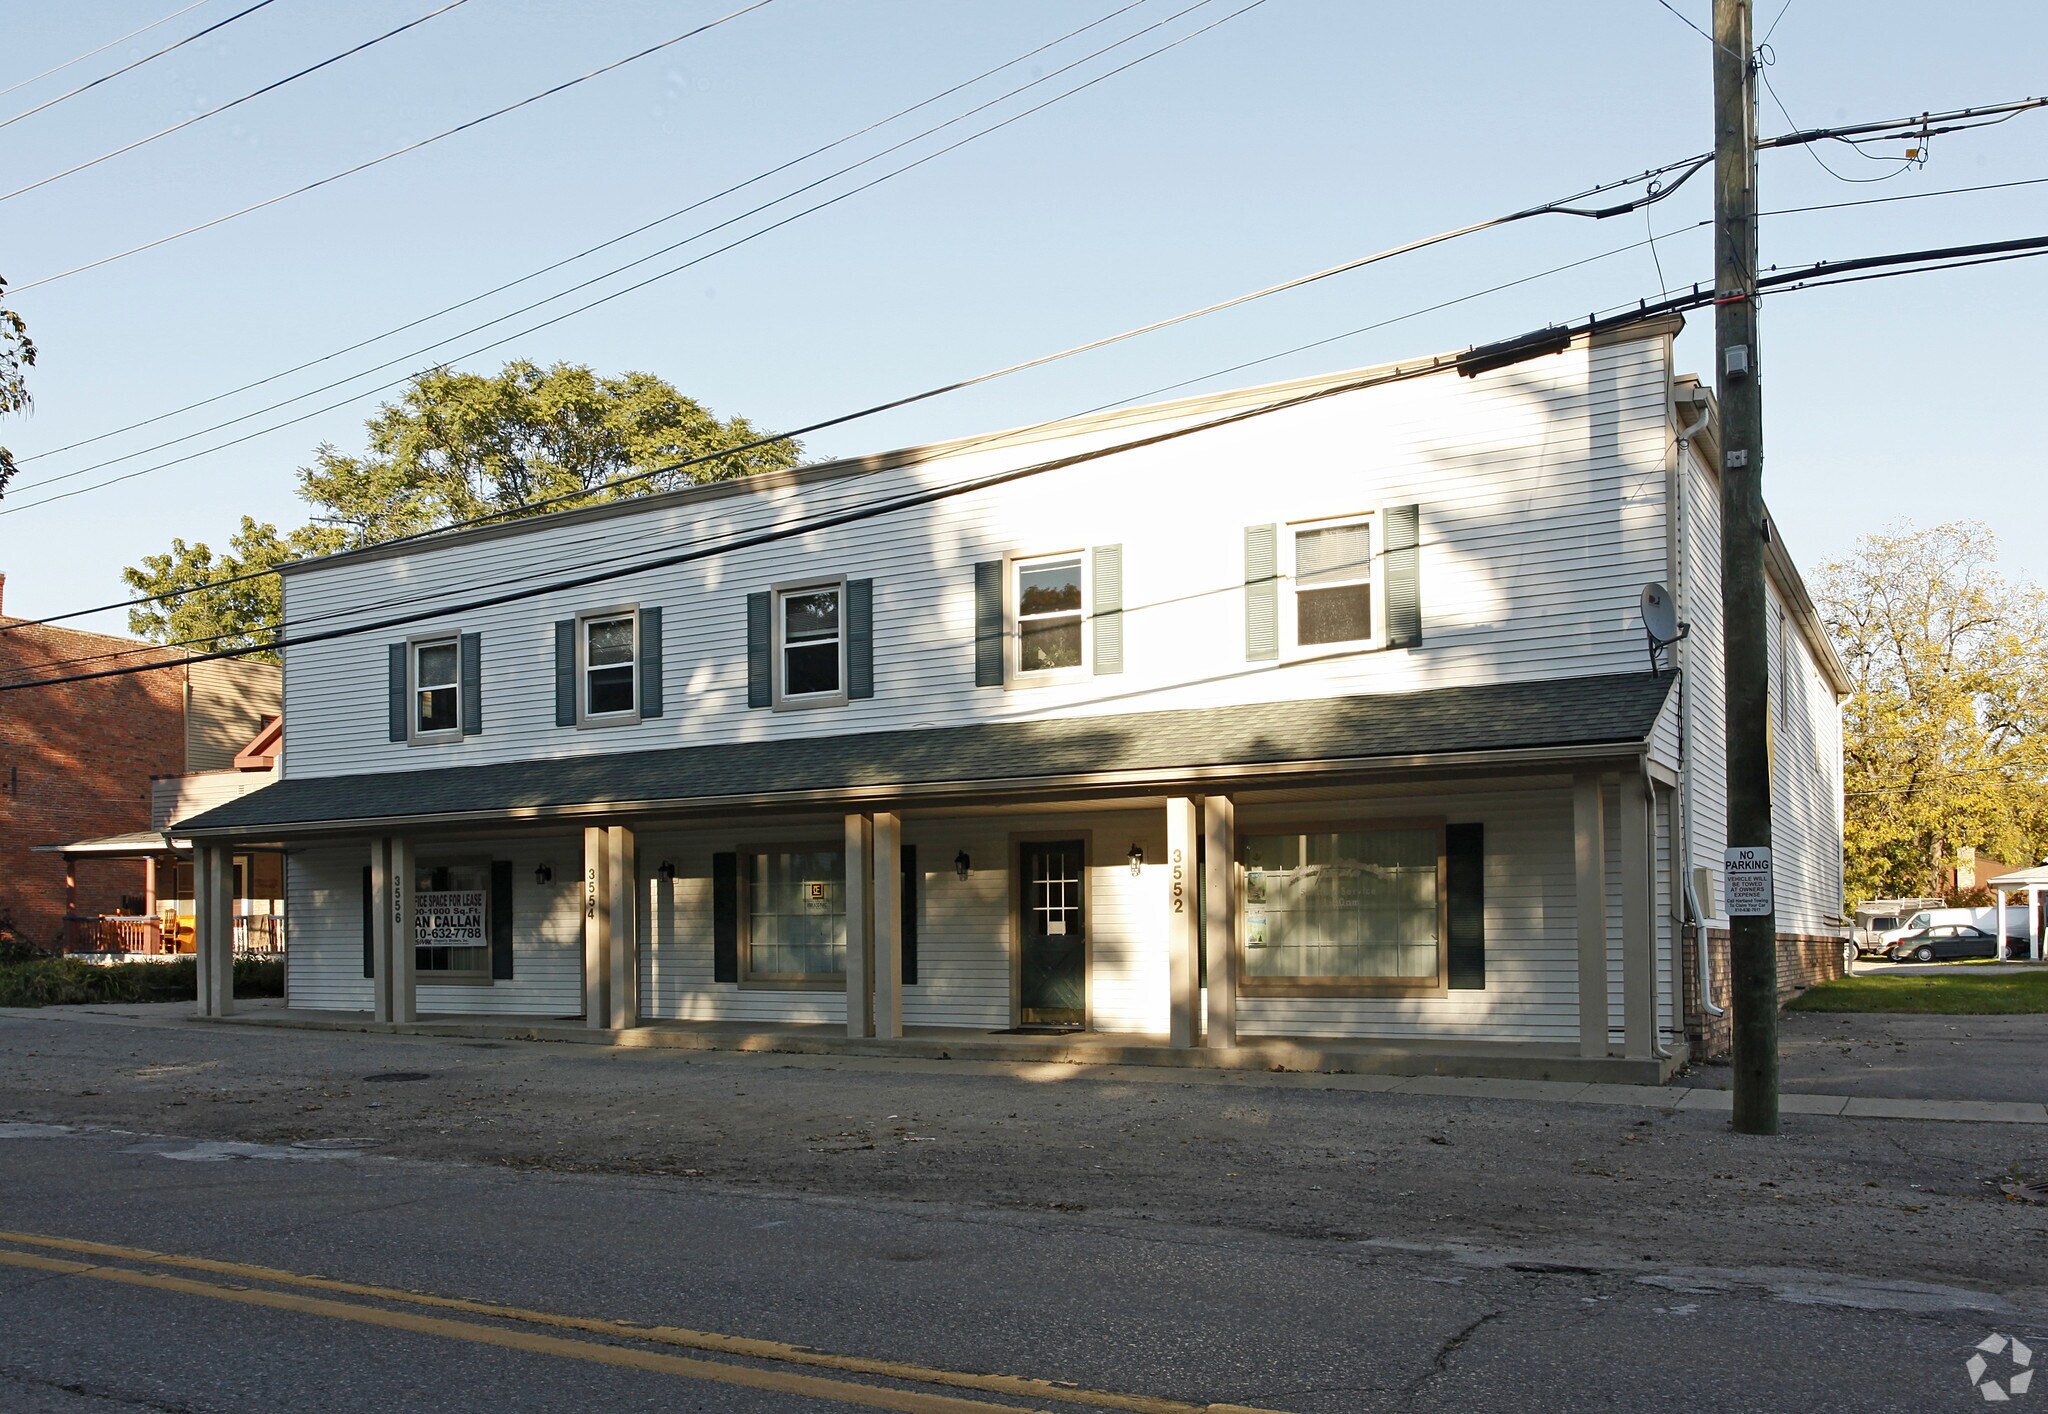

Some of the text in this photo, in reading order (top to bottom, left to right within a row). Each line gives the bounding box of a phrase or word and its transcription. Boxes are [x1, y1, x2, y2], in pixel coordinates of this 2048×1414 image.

[1740, 850, 1754, 860] NO
[1725, 860, 1769, 870] PARKING
[1173, 849, 1183, 913] 3552
[587, 868, 595, 920] 3554
[415, 893, 482, 908] FICE SPACE FOR LEASE
[415, 907, 481, 916] 00-1000 Sq.Ft.
[415, 915, 481, 928] AN CALLAN
[415, 928, 482, 939] 10-632-7788
